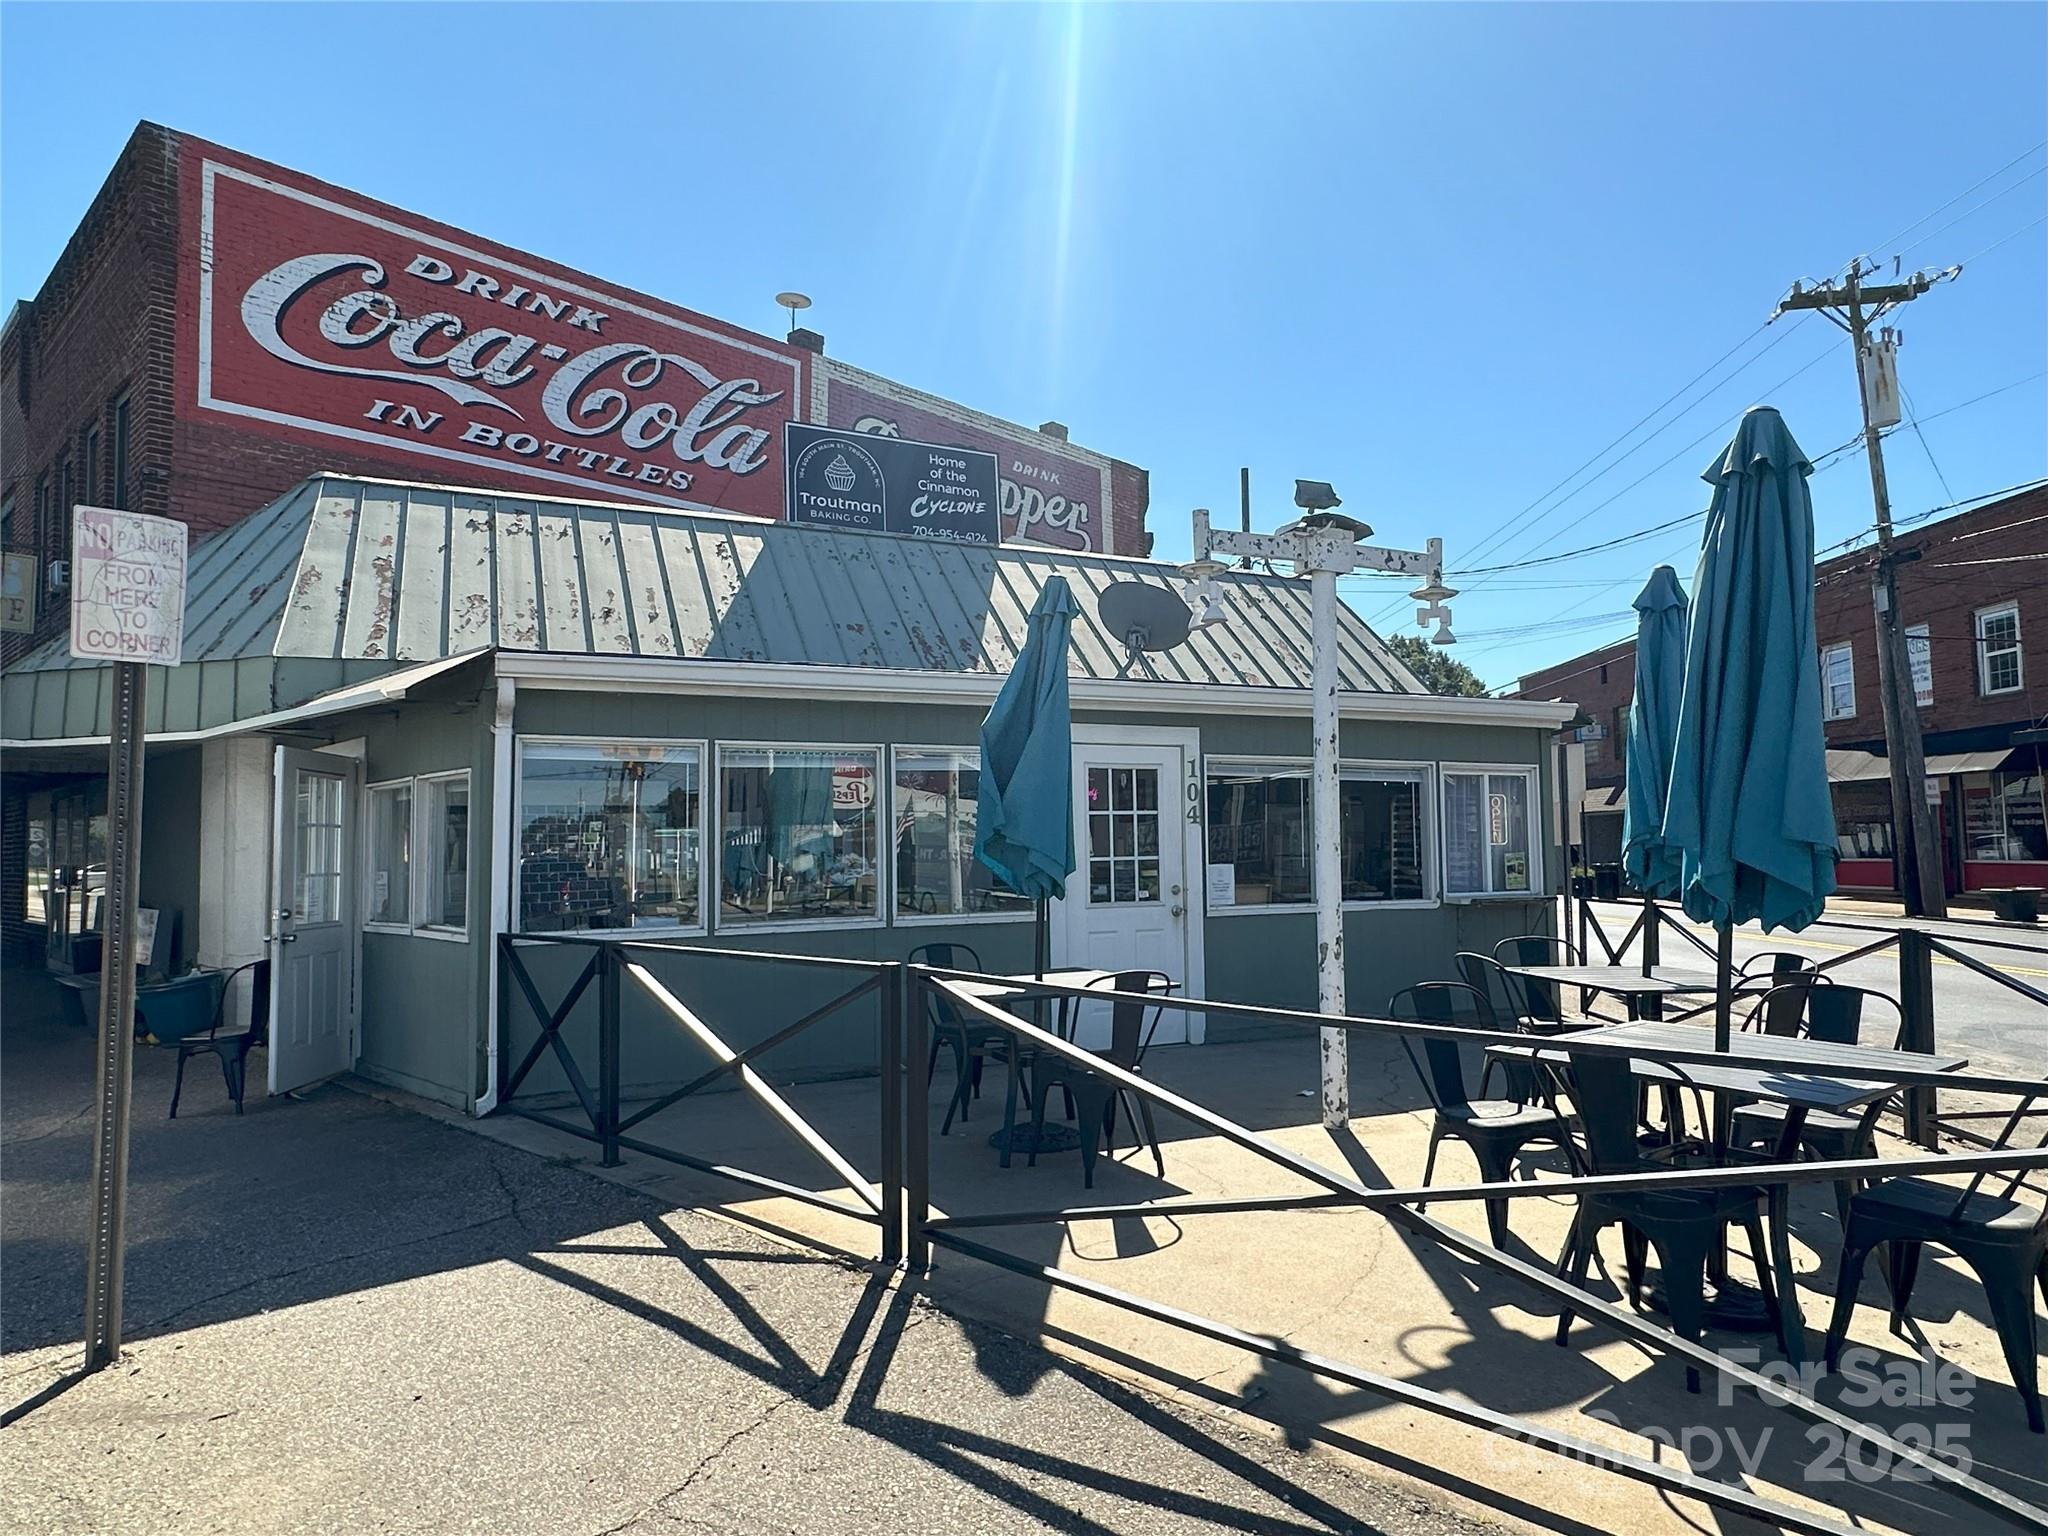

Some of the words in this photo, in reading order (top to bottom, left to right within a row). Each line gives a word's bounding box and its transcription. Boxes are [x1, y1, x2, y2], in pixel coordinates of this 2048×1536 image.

[404, 254, 610, 333] DRINK
[241, 253, 784, 474] Coca-Cola
[364, 399, 445, 434] IN
[458, 421, 695, 491] BOTTLES
[802, 448, 818, 466] SOUTH
[818, 443, 835, 451] MAIN
[929, 453, 967, 469] Home
[930, 468, 943, 480] of
[946, 470, 967, 483] the
[1012, 461, 1060, 485] DRINK
[918, 479, 980, 498] Cinnamon
[799, 491, 882, 514] Troutman
[810, 509, 851, 523] BAKING
[853, 515, 872, 525] CO.
[79, 523, 112, 549] NO
[105, 586, 161, 609] HERE
[121, 610, 147, 629] TO
[87, 629, 170, 655] CORNER
[1186, 757, 1201, 824] 104
[1491, 796, 1502, 843] OPEN
